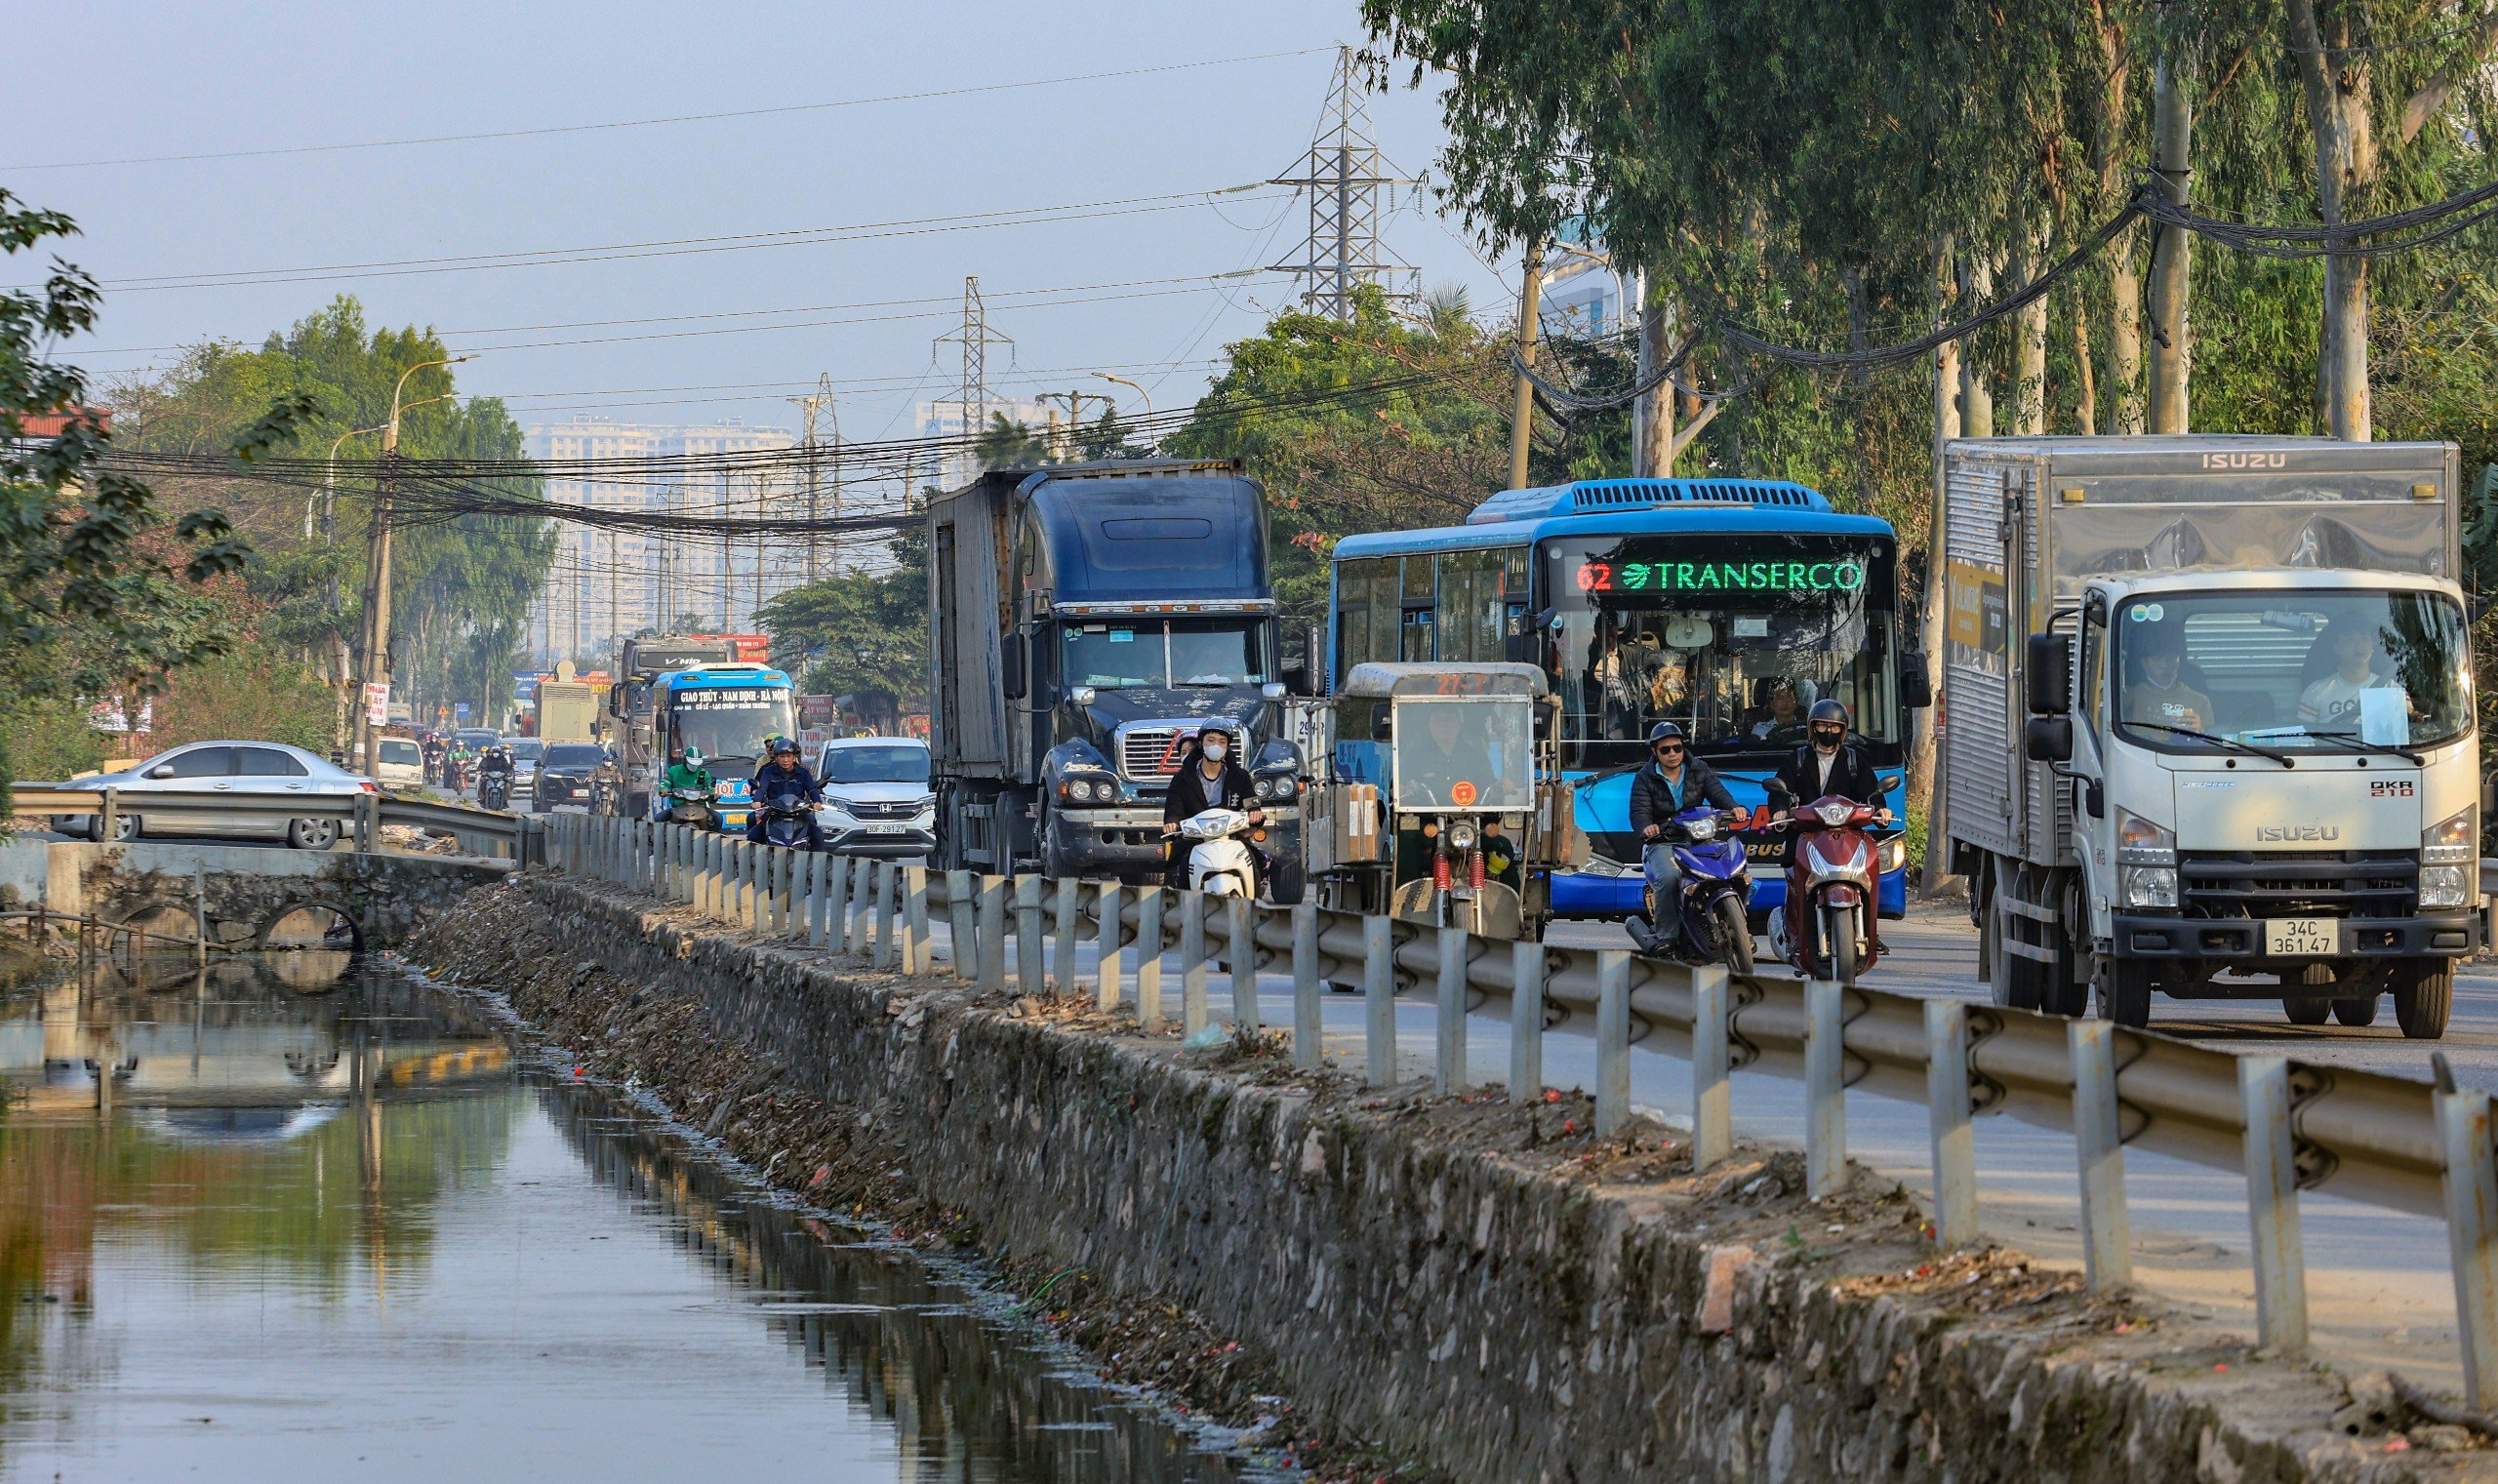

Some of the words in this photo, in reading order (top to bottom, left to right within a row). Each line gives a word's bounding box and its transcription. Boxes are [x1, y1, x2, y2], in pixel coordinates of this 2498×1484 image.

[2202, 453, 2285, 468] ISUZU
[1577, 563, 1611, 590] 62
[1655, 563, 1862, 589] TRANSERCO
[680, 692, 698, 702] GIAO
[723, 691, 738, 702] NAM
[2371, 781, 2412, 789] QKR
[2257, 825, 2340, 841] ISUZU
[1746, 844, 1785, 857] BUS
[2287, 921, 2317, 936] 34C
[2275, 938, 2330, 952] 361.47
